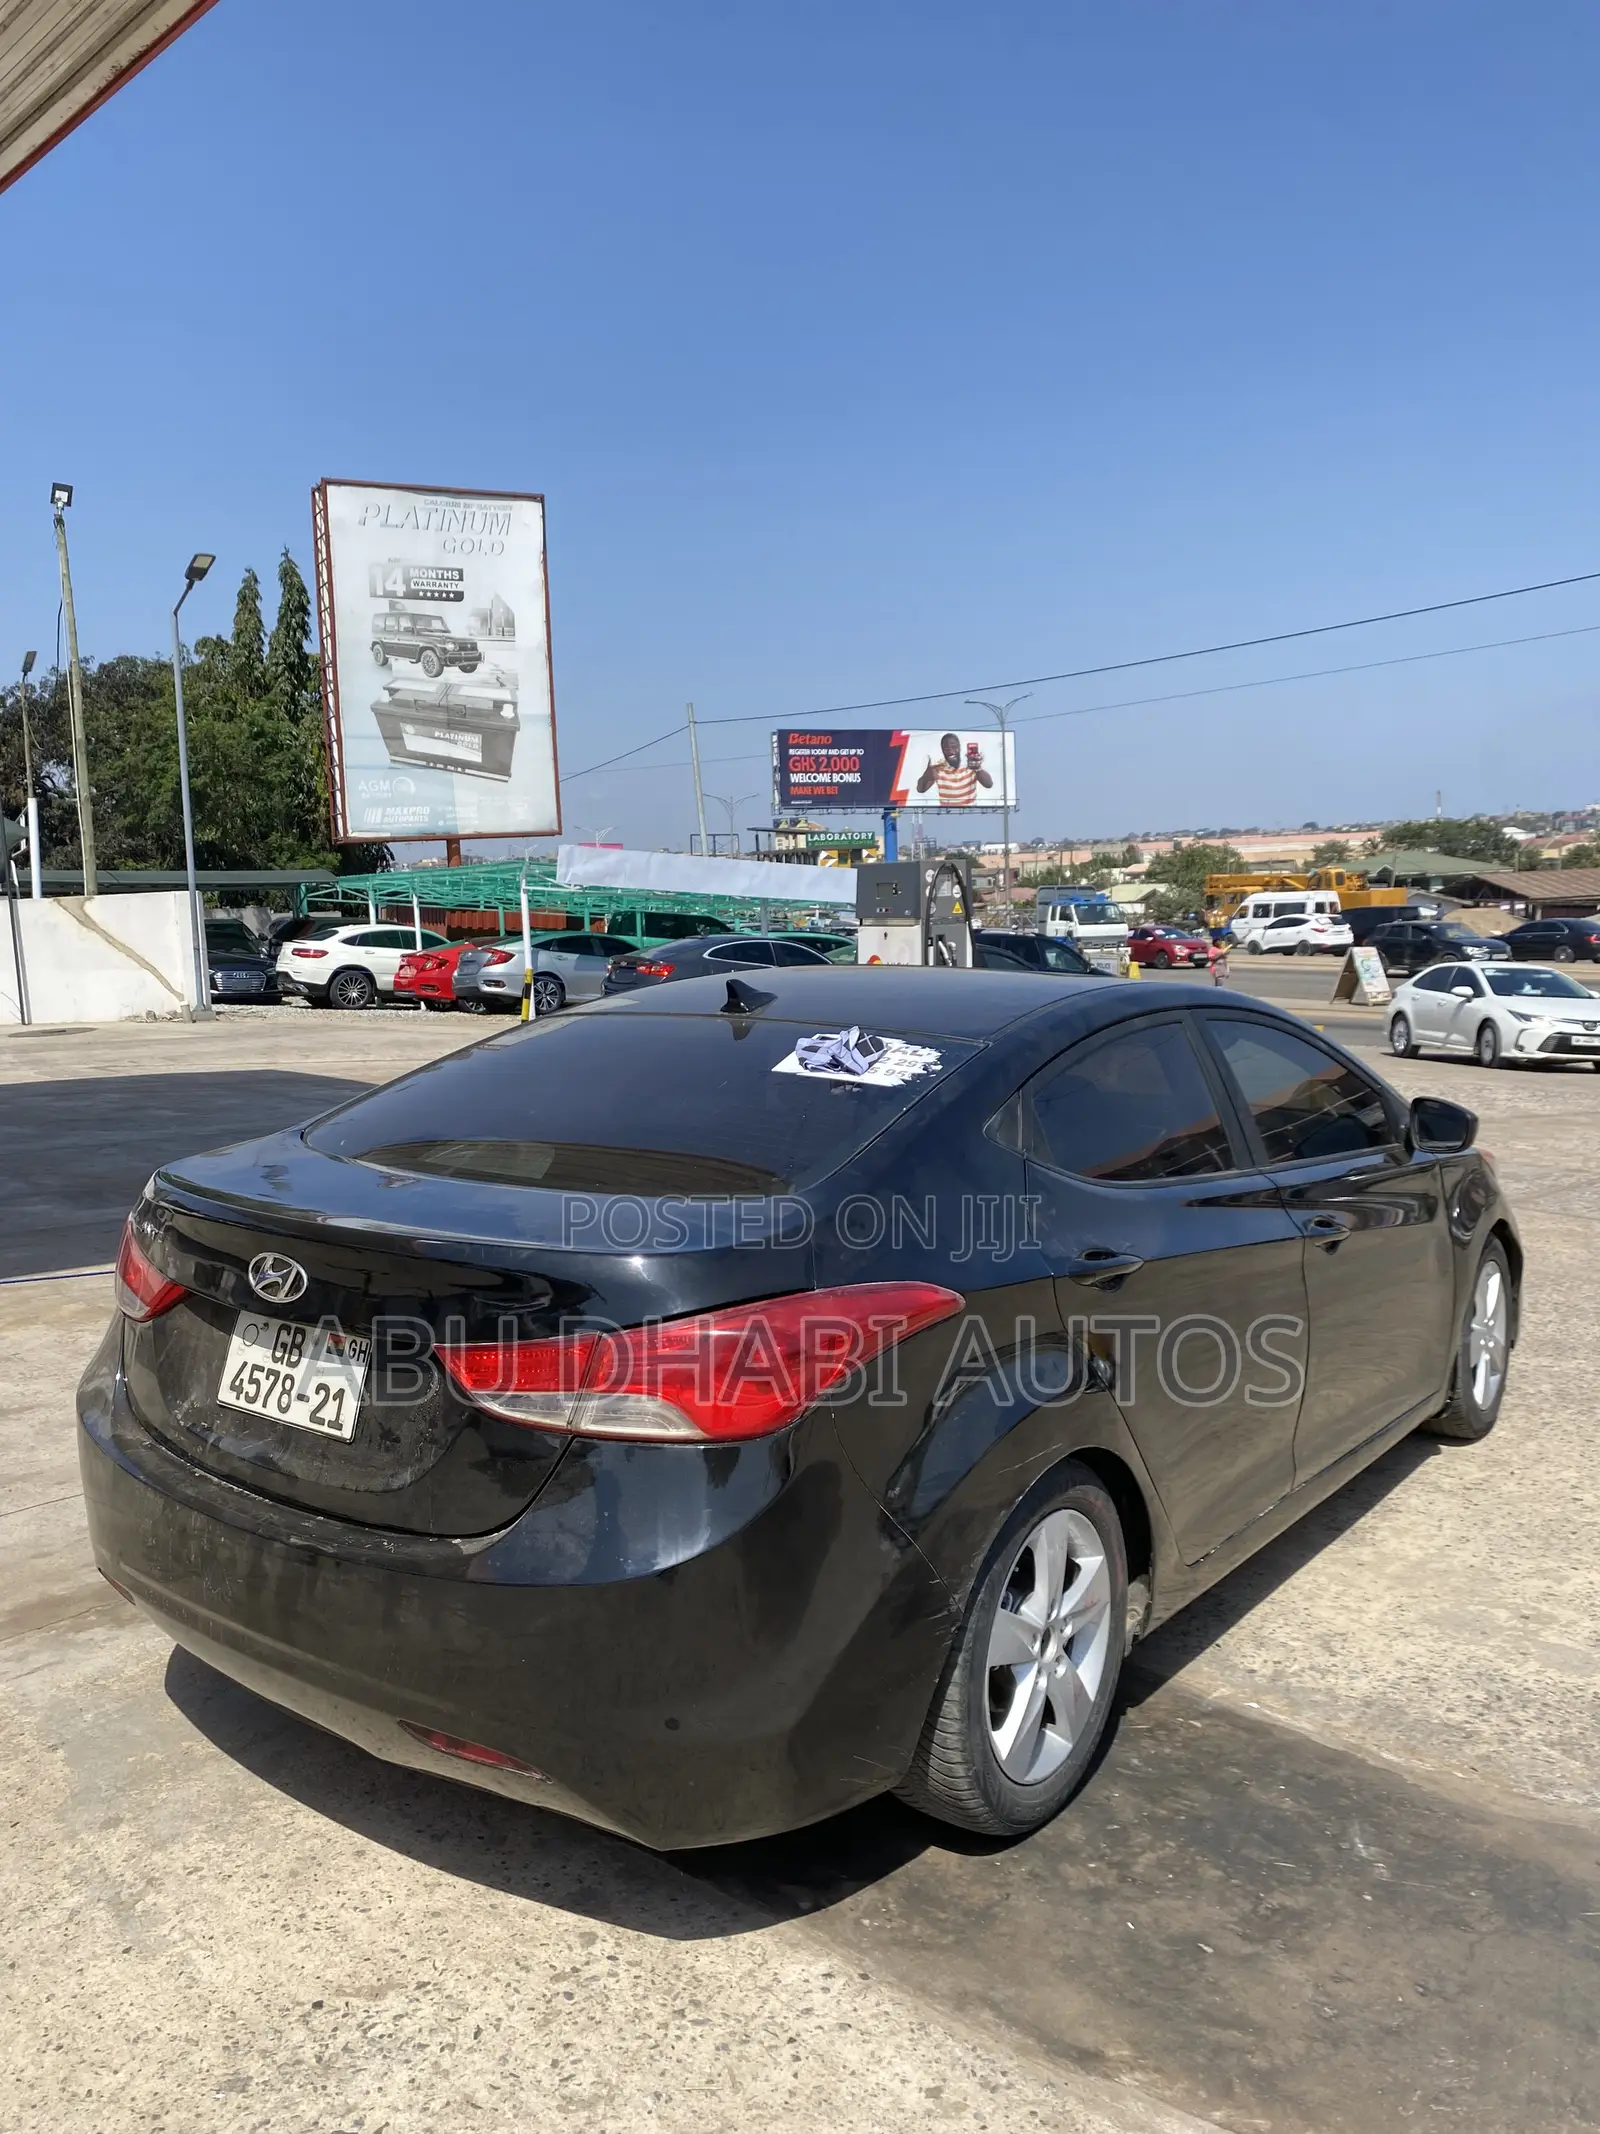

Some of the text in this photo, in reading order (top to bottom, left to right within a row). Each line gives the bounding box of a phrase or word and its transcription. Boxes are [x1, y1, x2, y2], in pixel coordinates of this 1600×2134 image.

[358, 503, 511, 536] PLATINUM
[443, 536, 505, 556] GOLD
[409, 568, 460, 580] MONTHS
[371, 565, 406, 597] 14
[412, 580, 460, 589] WARRANTY
[434, 731, 480, 743] PLATINUM
[788, 732, 833, 745] Betano
[811, 748, 828, 756] TODAY
[828, 748, 840, 756] AND
[840, 748, 850, 756] GET
[849, 748, 857, 756] UP
[856, 748, 865, 756] TO
[789, 756, 860, 773] GHS 2,000
[790, 772, 862, 783] WELCOME BONUS
[358, 779, 391, 793] AGM
[790, 786, 839, 795] MAKE WE BET
[384, 805, 430, 815] MAXPRO
[807, 832, 873, 841] LABORATORY
[271, 1323, 369, 1368] GB GH
[229, 1361, 346, 1431] 4578-21
